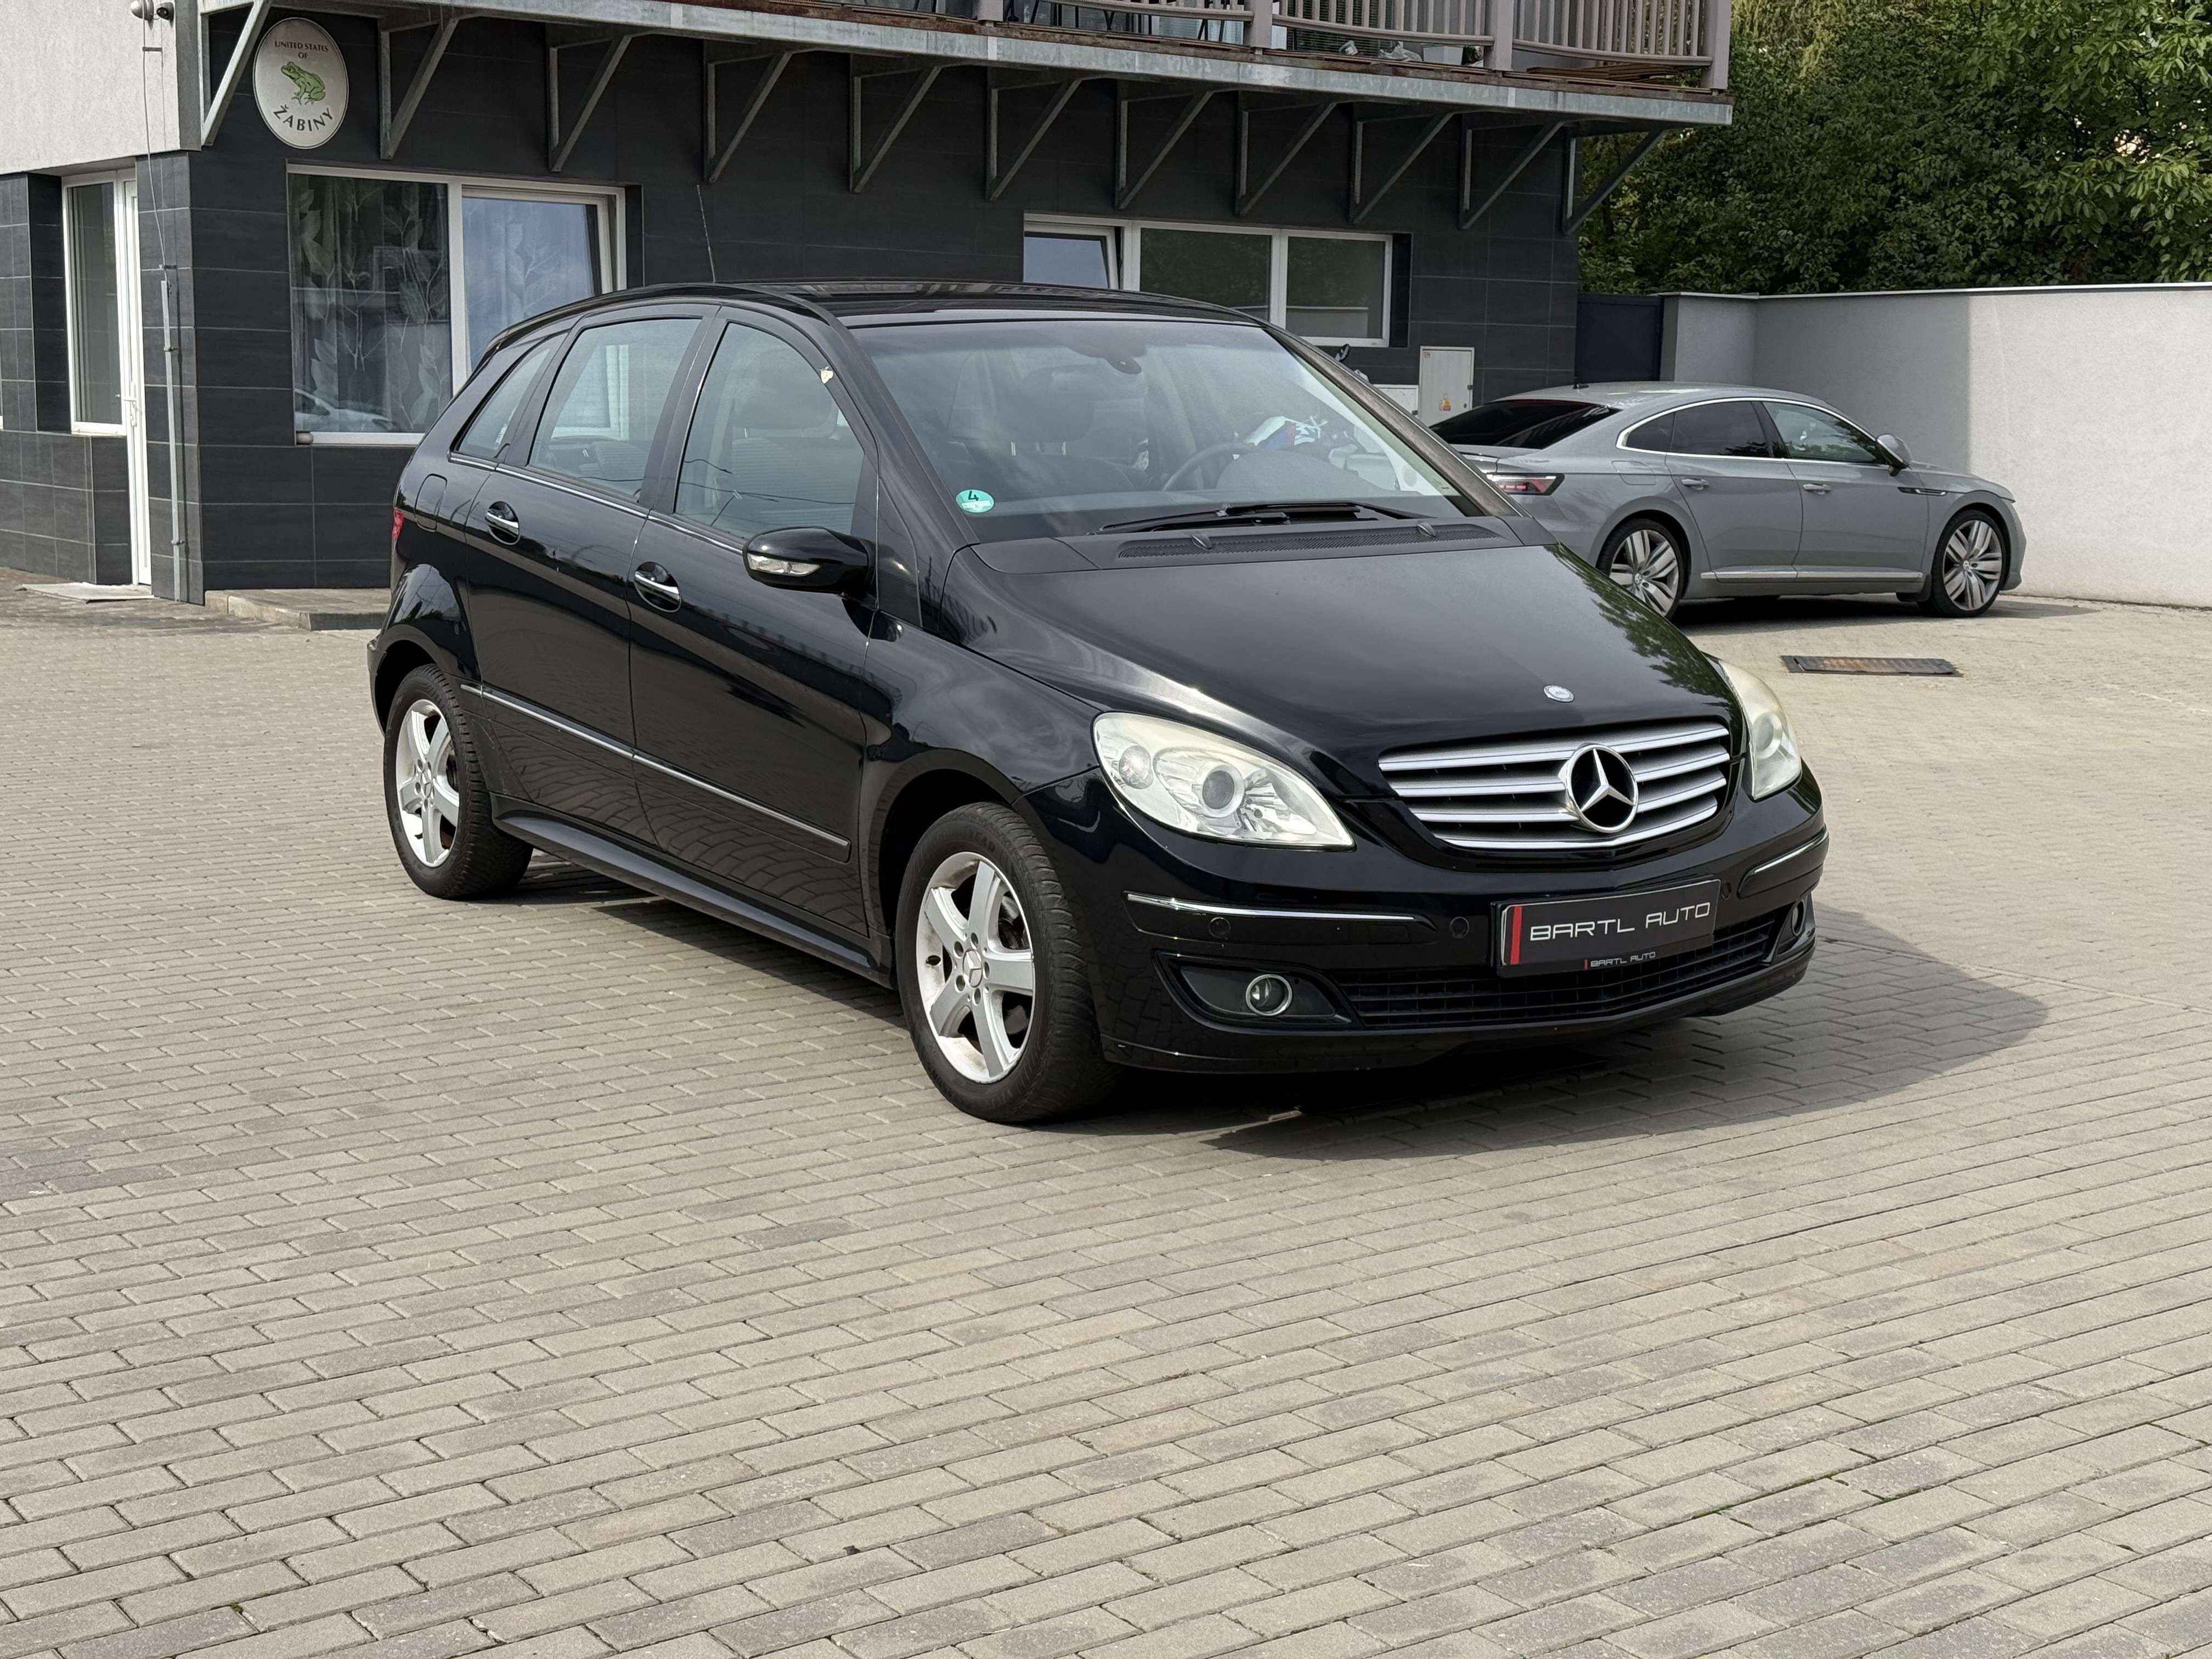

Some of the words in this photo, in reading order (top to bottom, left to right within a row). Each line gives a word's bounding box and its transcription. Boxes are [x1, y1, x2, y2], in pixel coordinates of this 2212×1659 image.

[274, 41, 303, 49] UNITED
[304, 43, 329, 53] STATES
[273, 104, 334, 132] ŽABINY
[968, 490, 979, 501] 4
[1530, 919, 1635, 941] BARTL
[1645, 902, 1711, 929] AUTO
[1590, 957, 1628, 967] BARTL
[1630, 951, 1656, 962] AUTO
